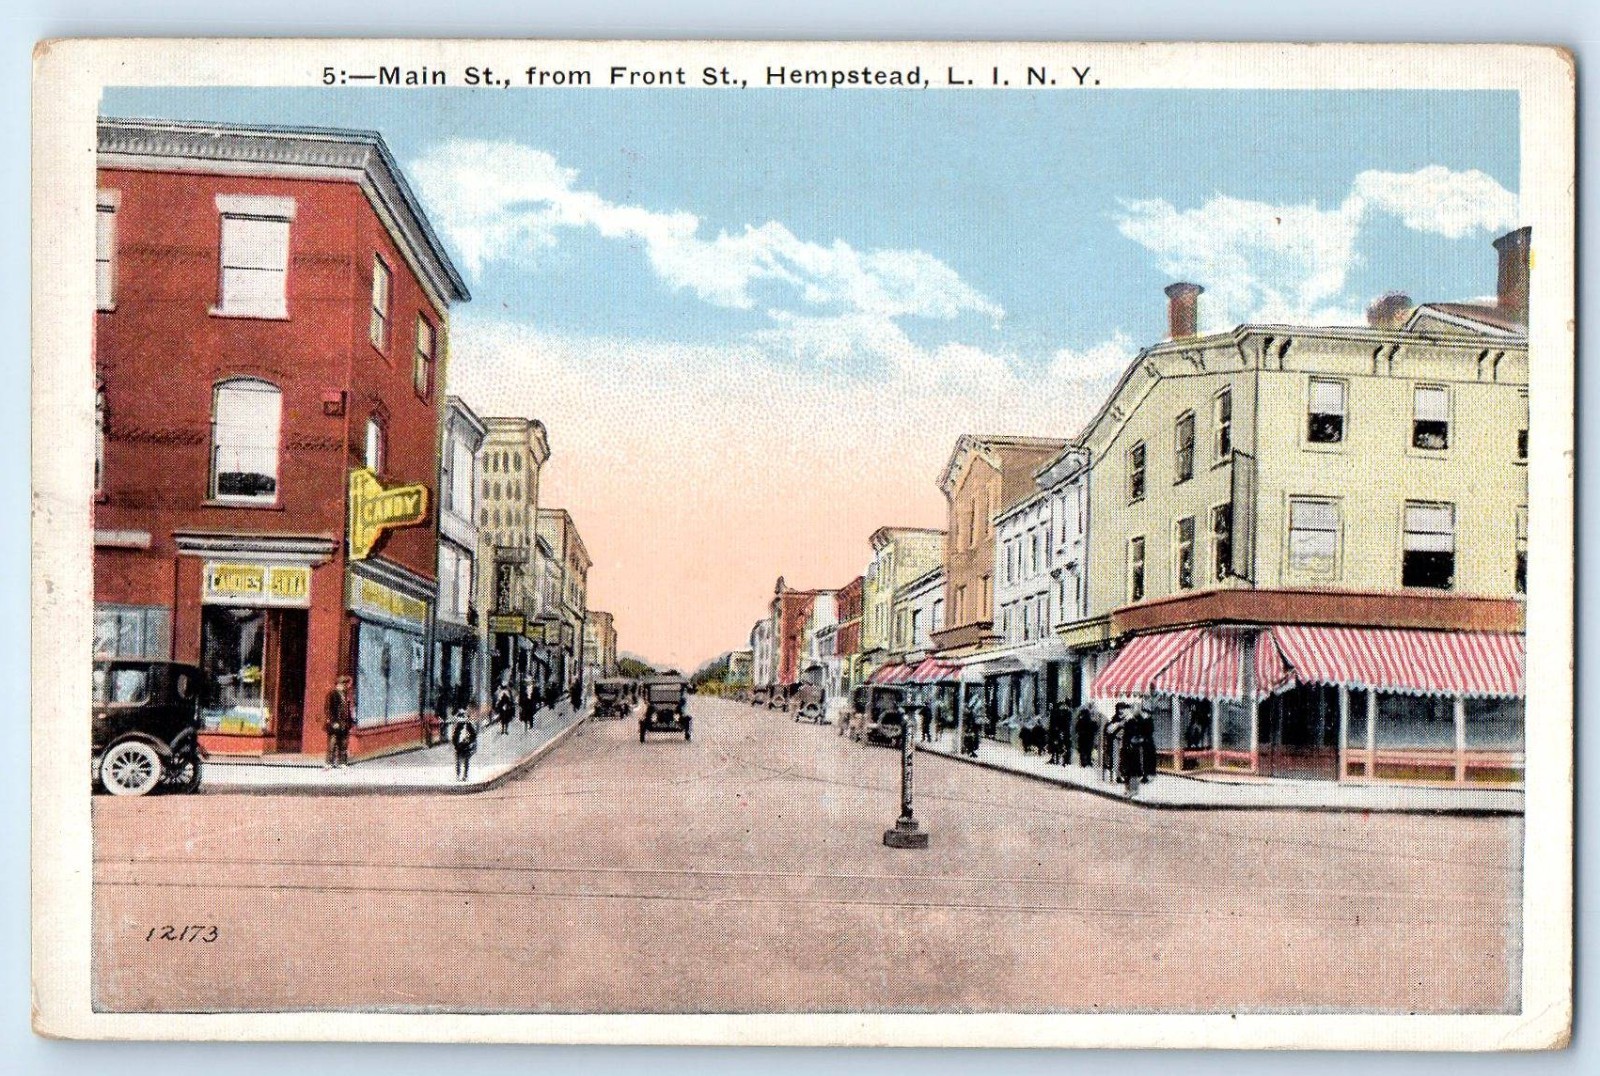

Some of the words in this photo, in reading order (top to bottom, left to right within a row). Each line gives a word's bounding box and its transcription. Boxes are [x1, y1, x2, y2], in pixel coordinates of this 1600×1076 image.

[463, 66, 511, 90] St.,
[524, 66, 592, 86] from
[609, 66, 687, 86] Front
[702, 66, 748, 90] St.,
[765, 66, 930, 90] Hempstead,
[947, 66, 974, 86] L.
[992, 66, 1010, 86] I.
[1026, 66, 1057, 86] N.
[1071, 66, 1101, 86] Y.
[364, 494, 420, 522] CANDY
[146, 925, 218, 943] 12173
